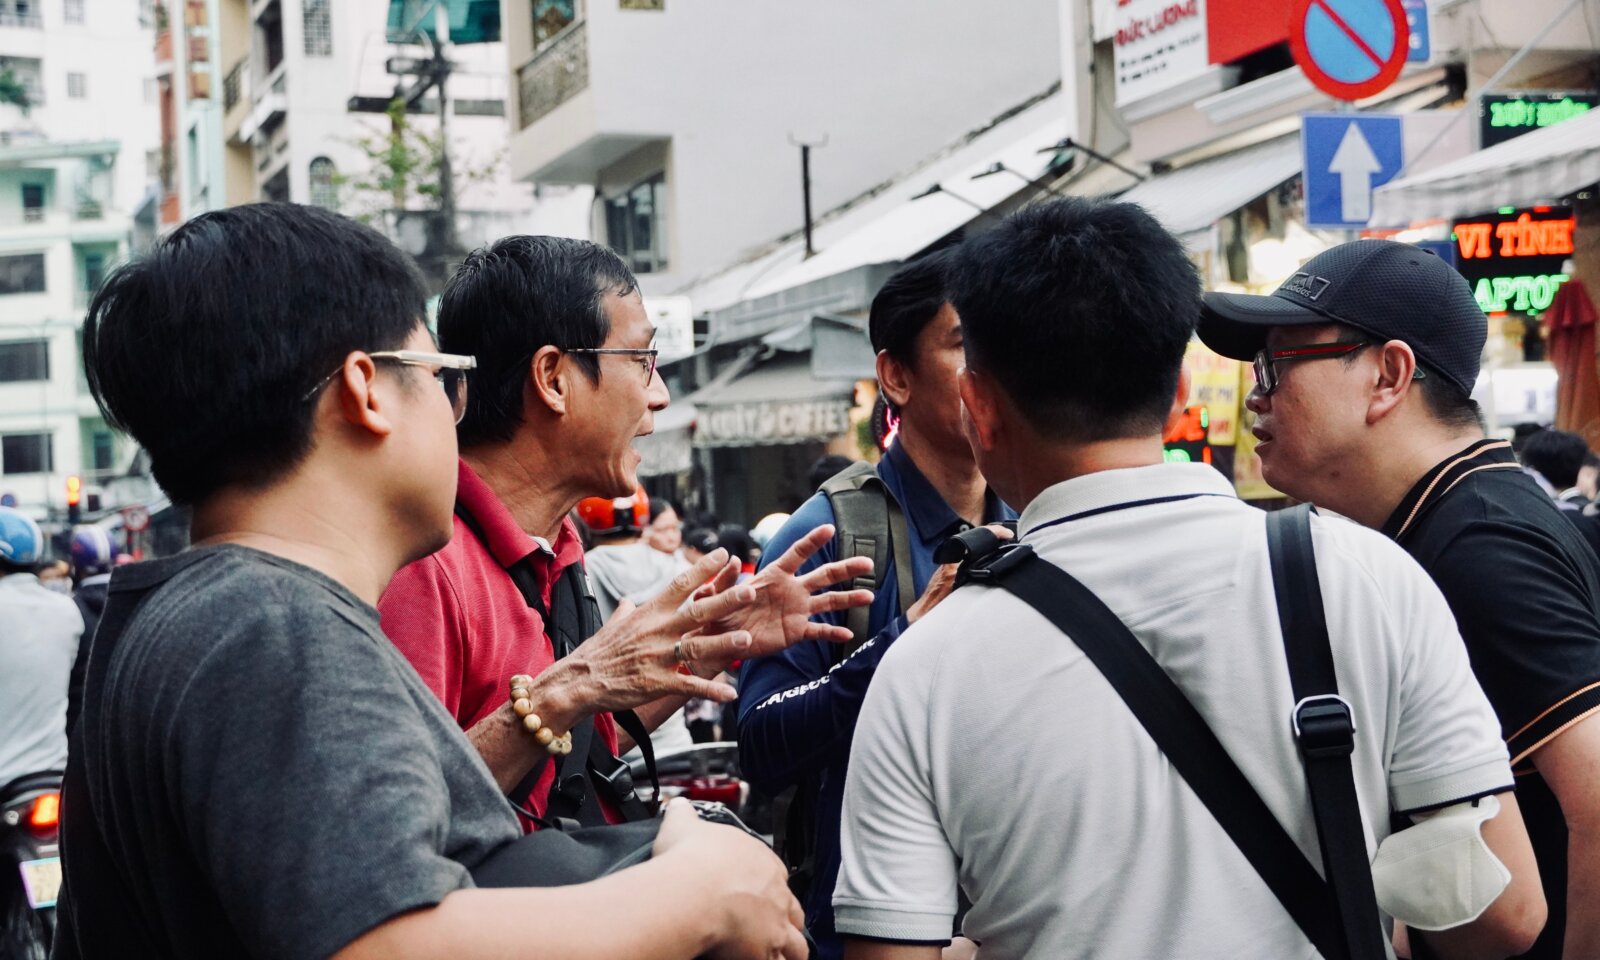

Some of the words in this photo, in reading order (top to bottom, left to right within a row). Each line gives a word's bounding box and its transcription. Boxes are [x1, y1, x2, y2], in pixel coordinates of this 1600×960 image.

[1454, 223, 1492, 259] VI
[1496, 212, 1576, 257] TÍNH
[1474, 274, 1570, 313] APTO
